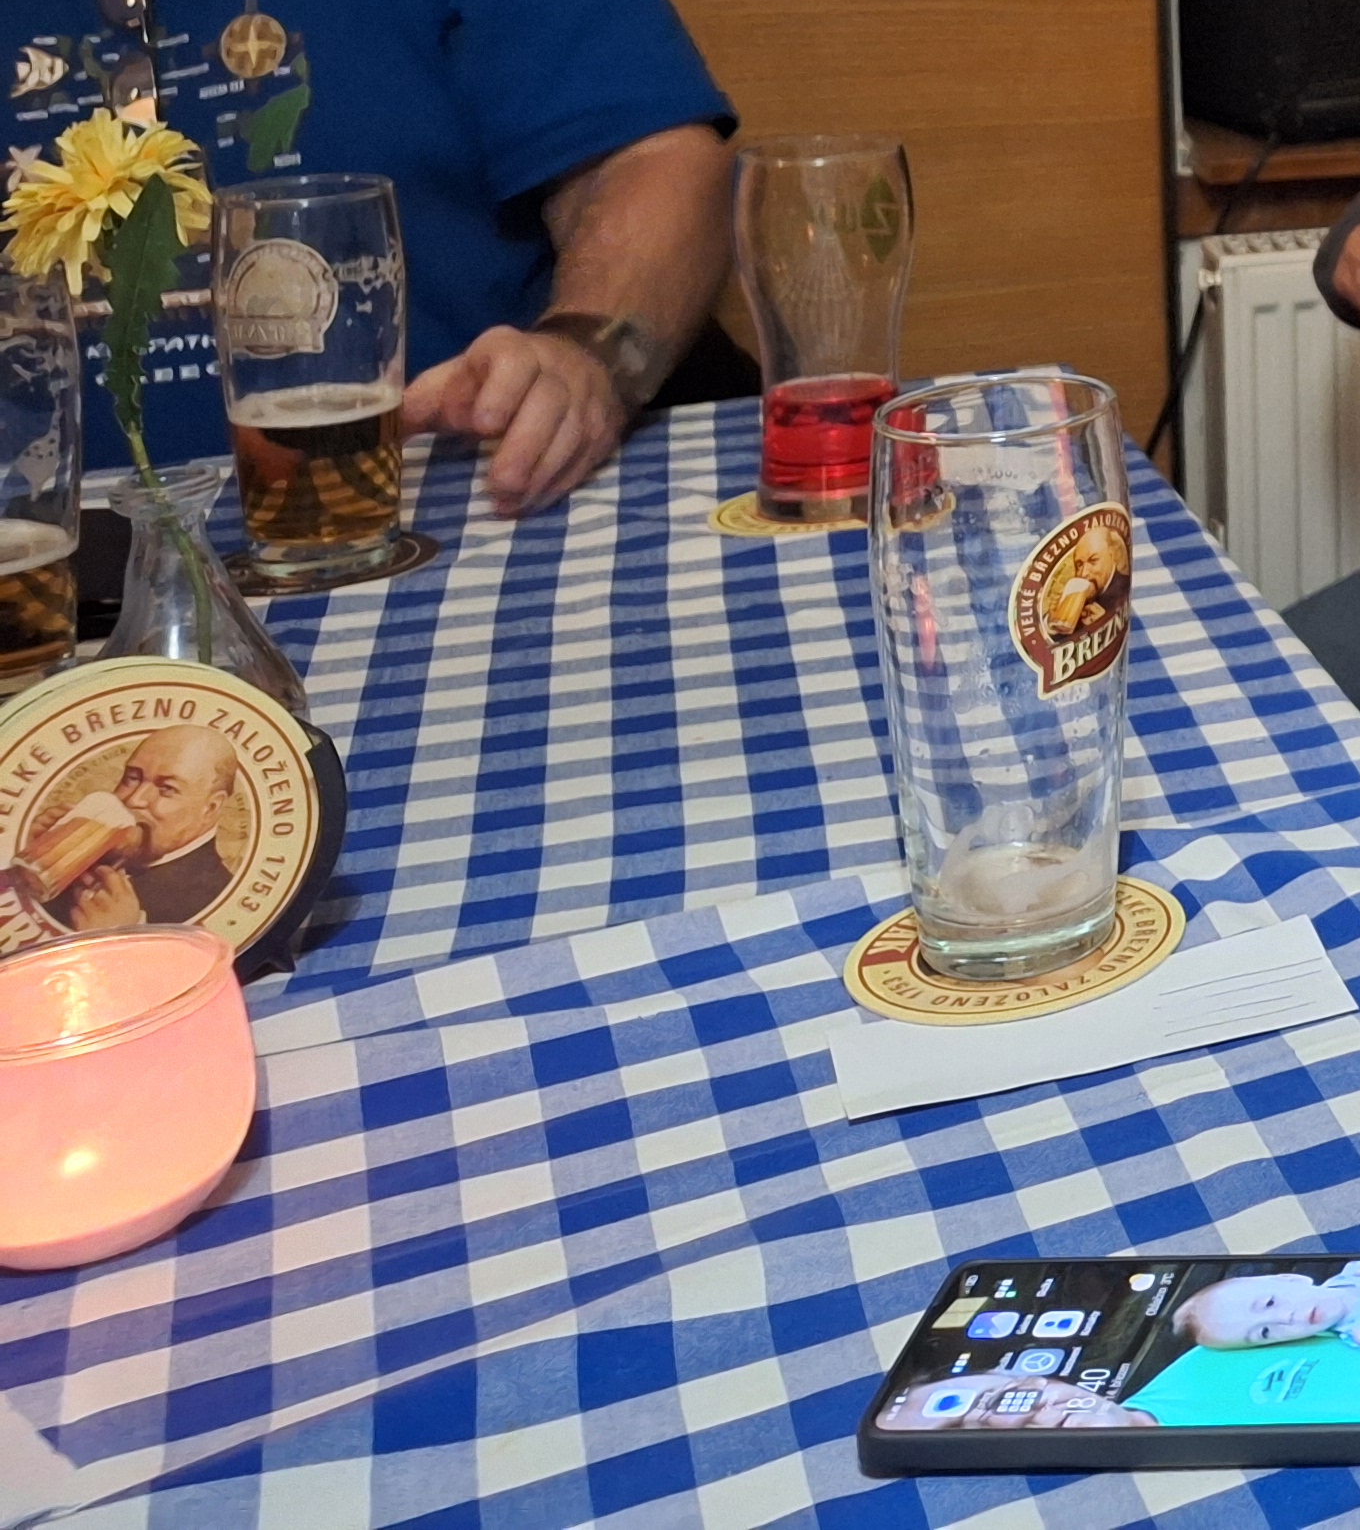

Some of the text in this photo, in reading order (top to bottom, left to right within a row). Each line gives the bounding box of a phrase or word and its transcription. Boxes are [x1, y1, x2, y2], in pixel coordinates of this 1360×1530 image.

[1020, 588, 1036, 637] VELKÉ
[1029, 528, 1079, 583] BŘEZNO
[61, 697, 197, 744] BŘEZNO
[207, 708, 295, 837] ZALOŽENO
[239, 854, 287, 914] 1753
[930, 977, 1091, 1007] ZALOŽENO
